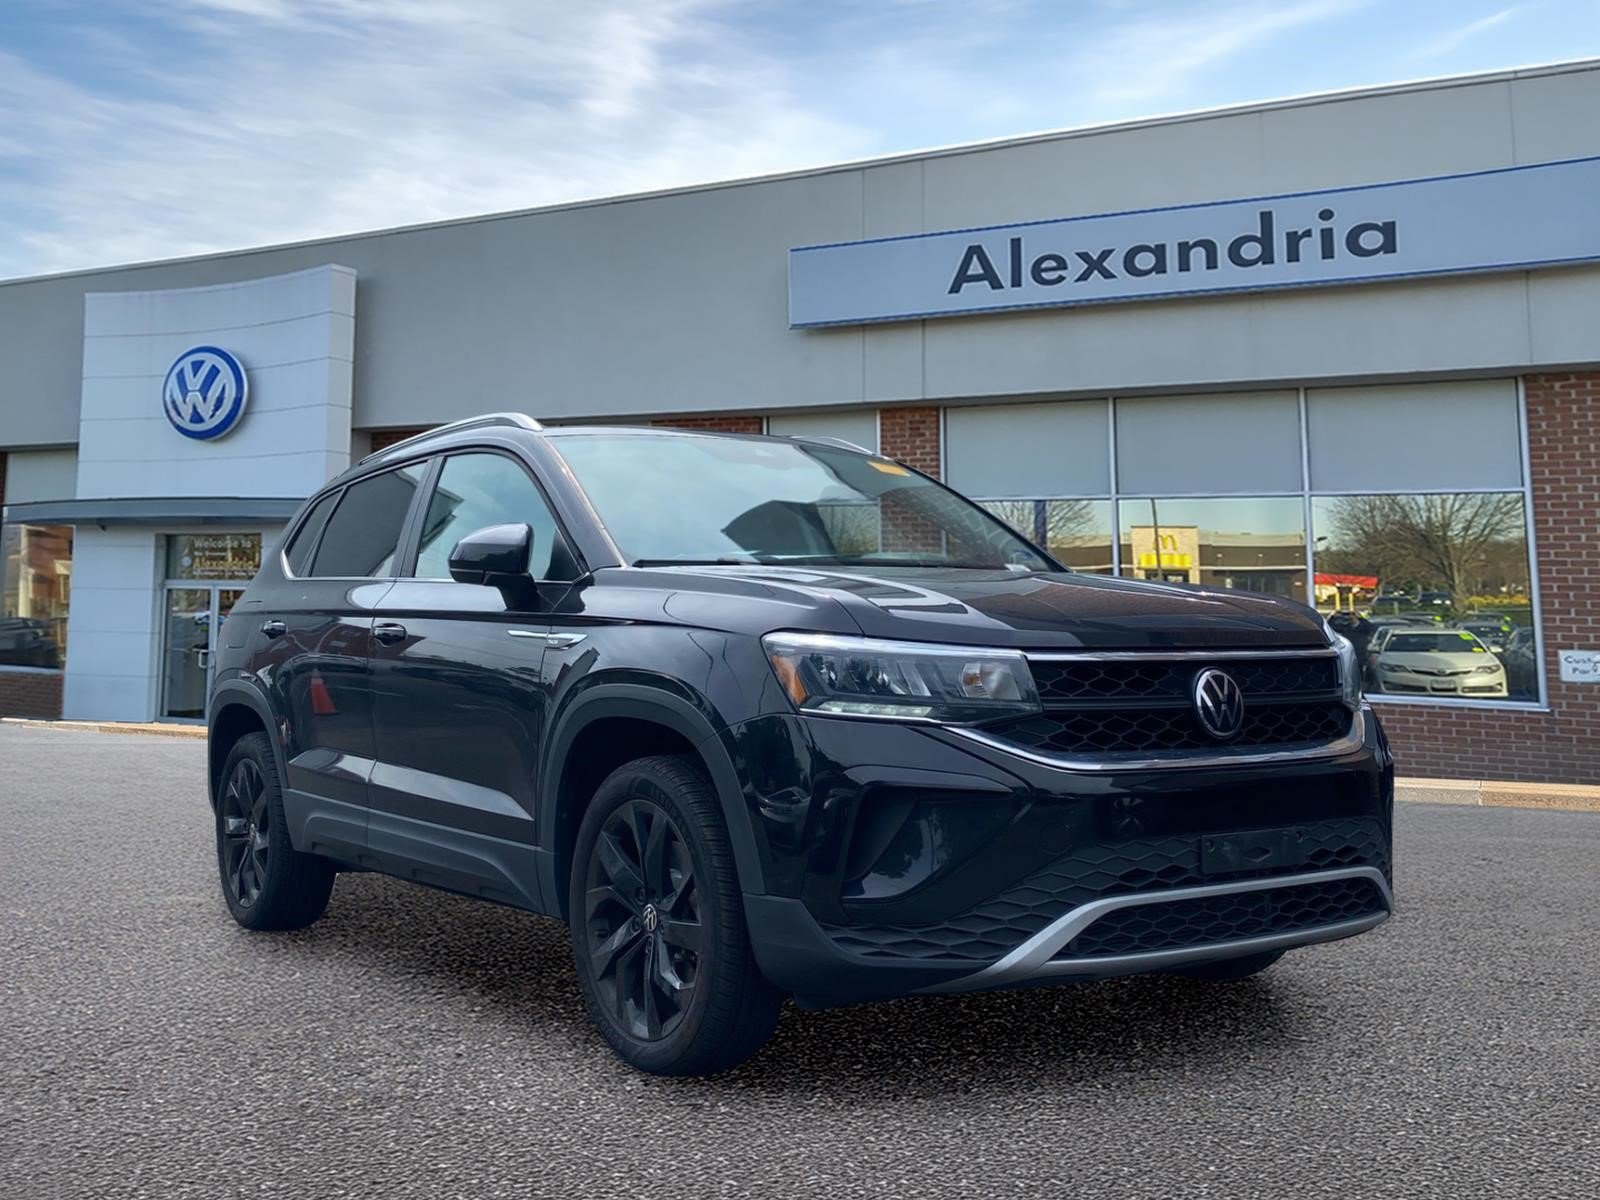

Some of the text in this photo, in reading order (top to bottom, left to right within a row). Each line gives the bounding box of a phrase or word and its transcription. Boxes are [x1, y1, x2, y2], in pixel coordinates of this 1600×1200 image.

[947, 207, 1398, 295] Alexandria
[165, 351, 237, 431] VW
[193, 538, 252, 548] Welcome to
[193, 556, 254, 569] Alexandria
[1196, 669, 1243, 736] VW
